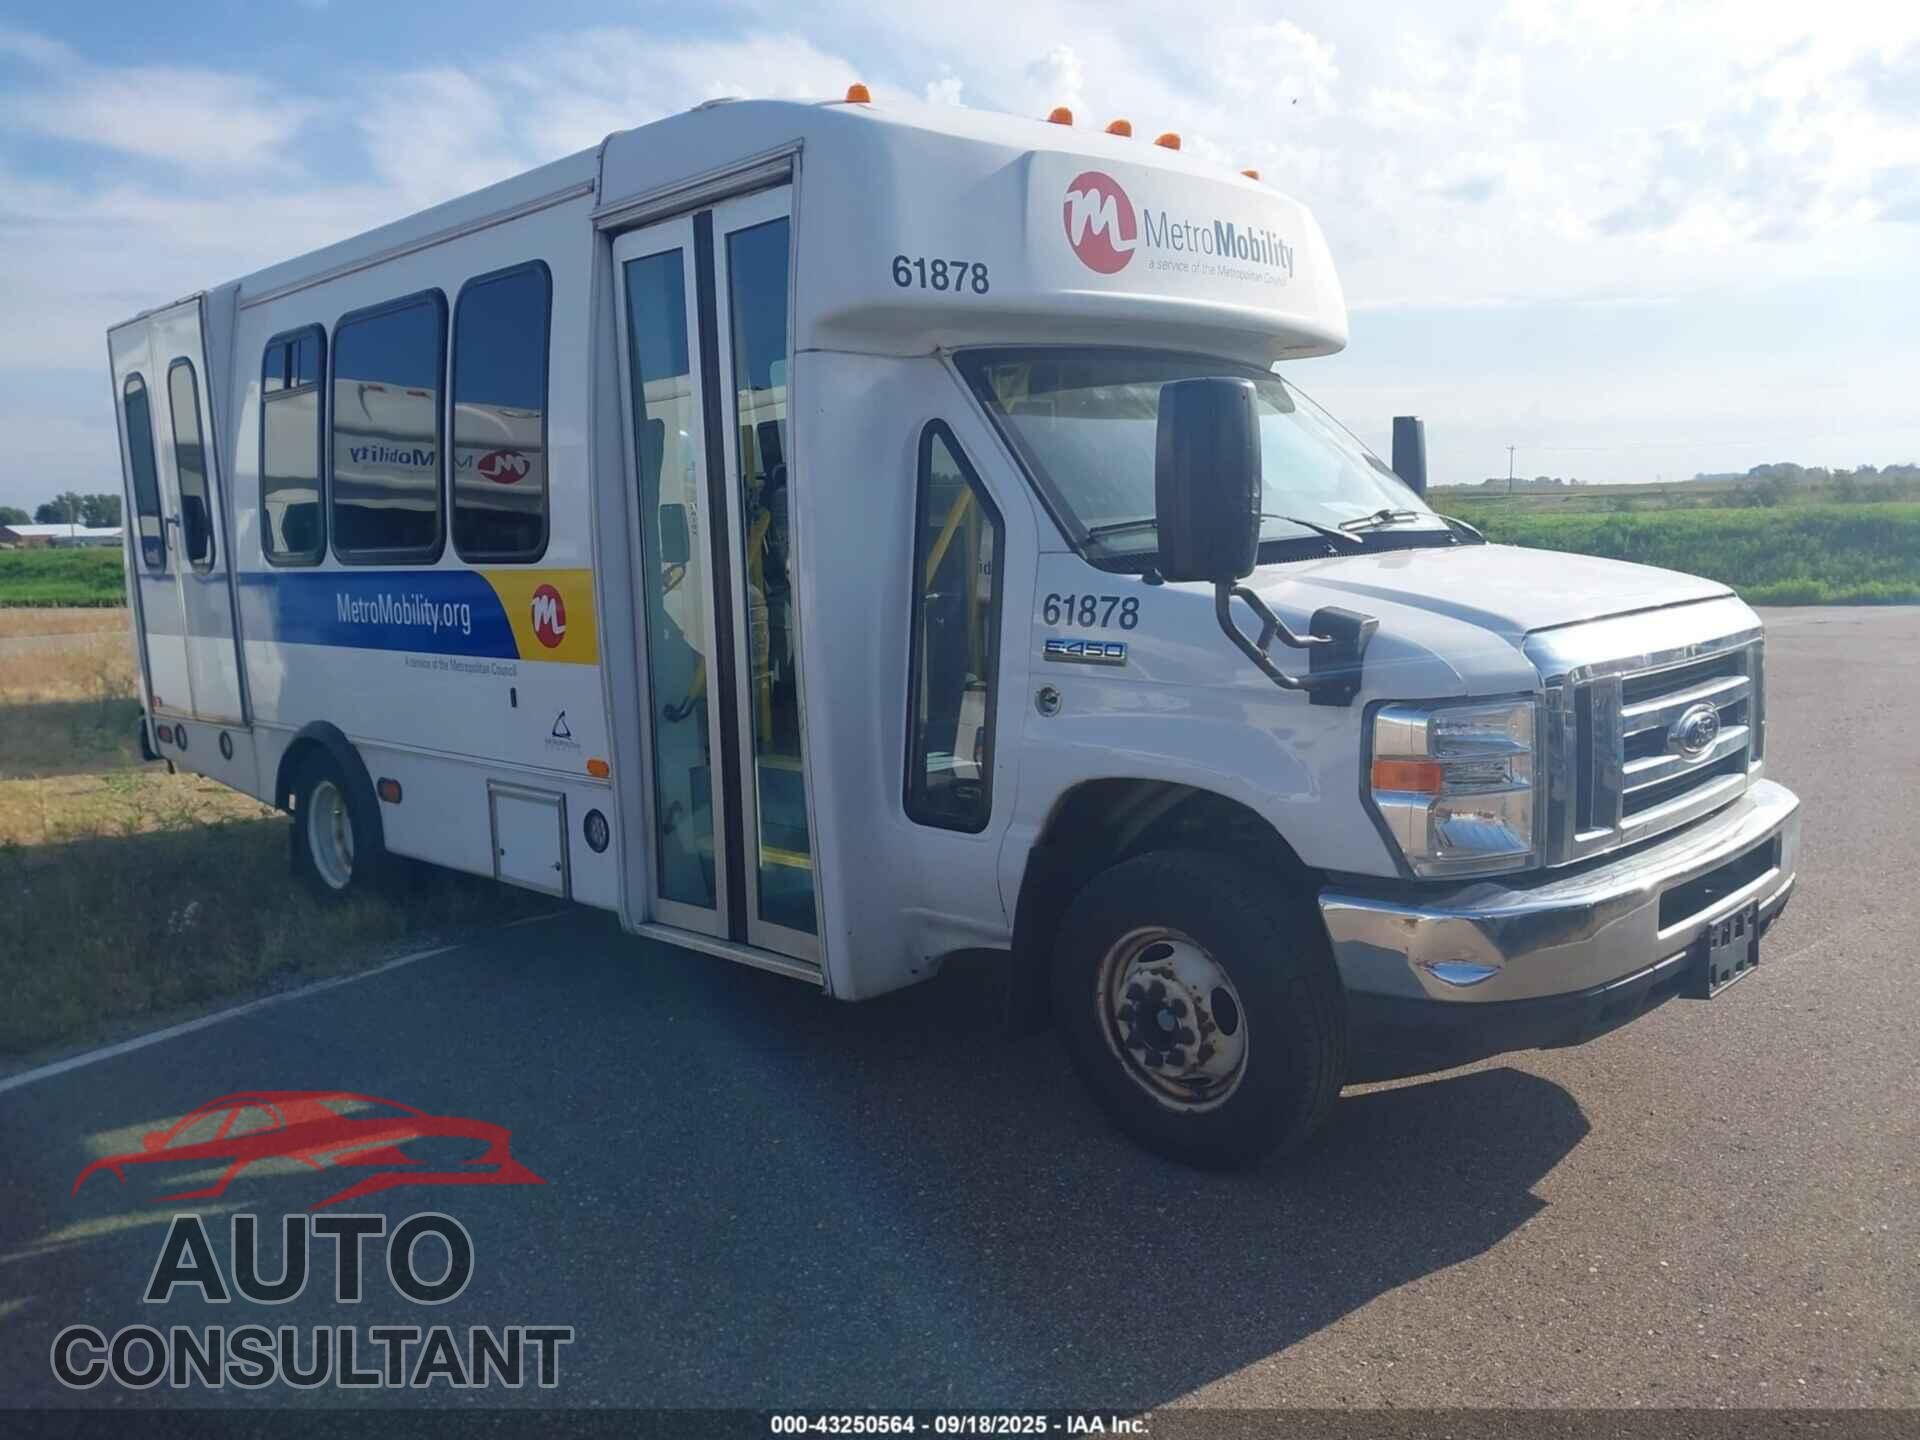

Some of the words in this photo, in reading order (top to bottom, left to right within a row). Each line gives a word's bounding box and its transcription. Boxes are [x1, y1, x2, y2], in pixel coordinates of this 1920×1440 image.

[1143, 208, 1293, 278] MetroMobility
[891, 254, 990, 294] 61878
[1157, 260, 1189, 272] service
[336, 592, 472, 636] MetroMobility.org
[1042, 592, 1140, 631] 61878
